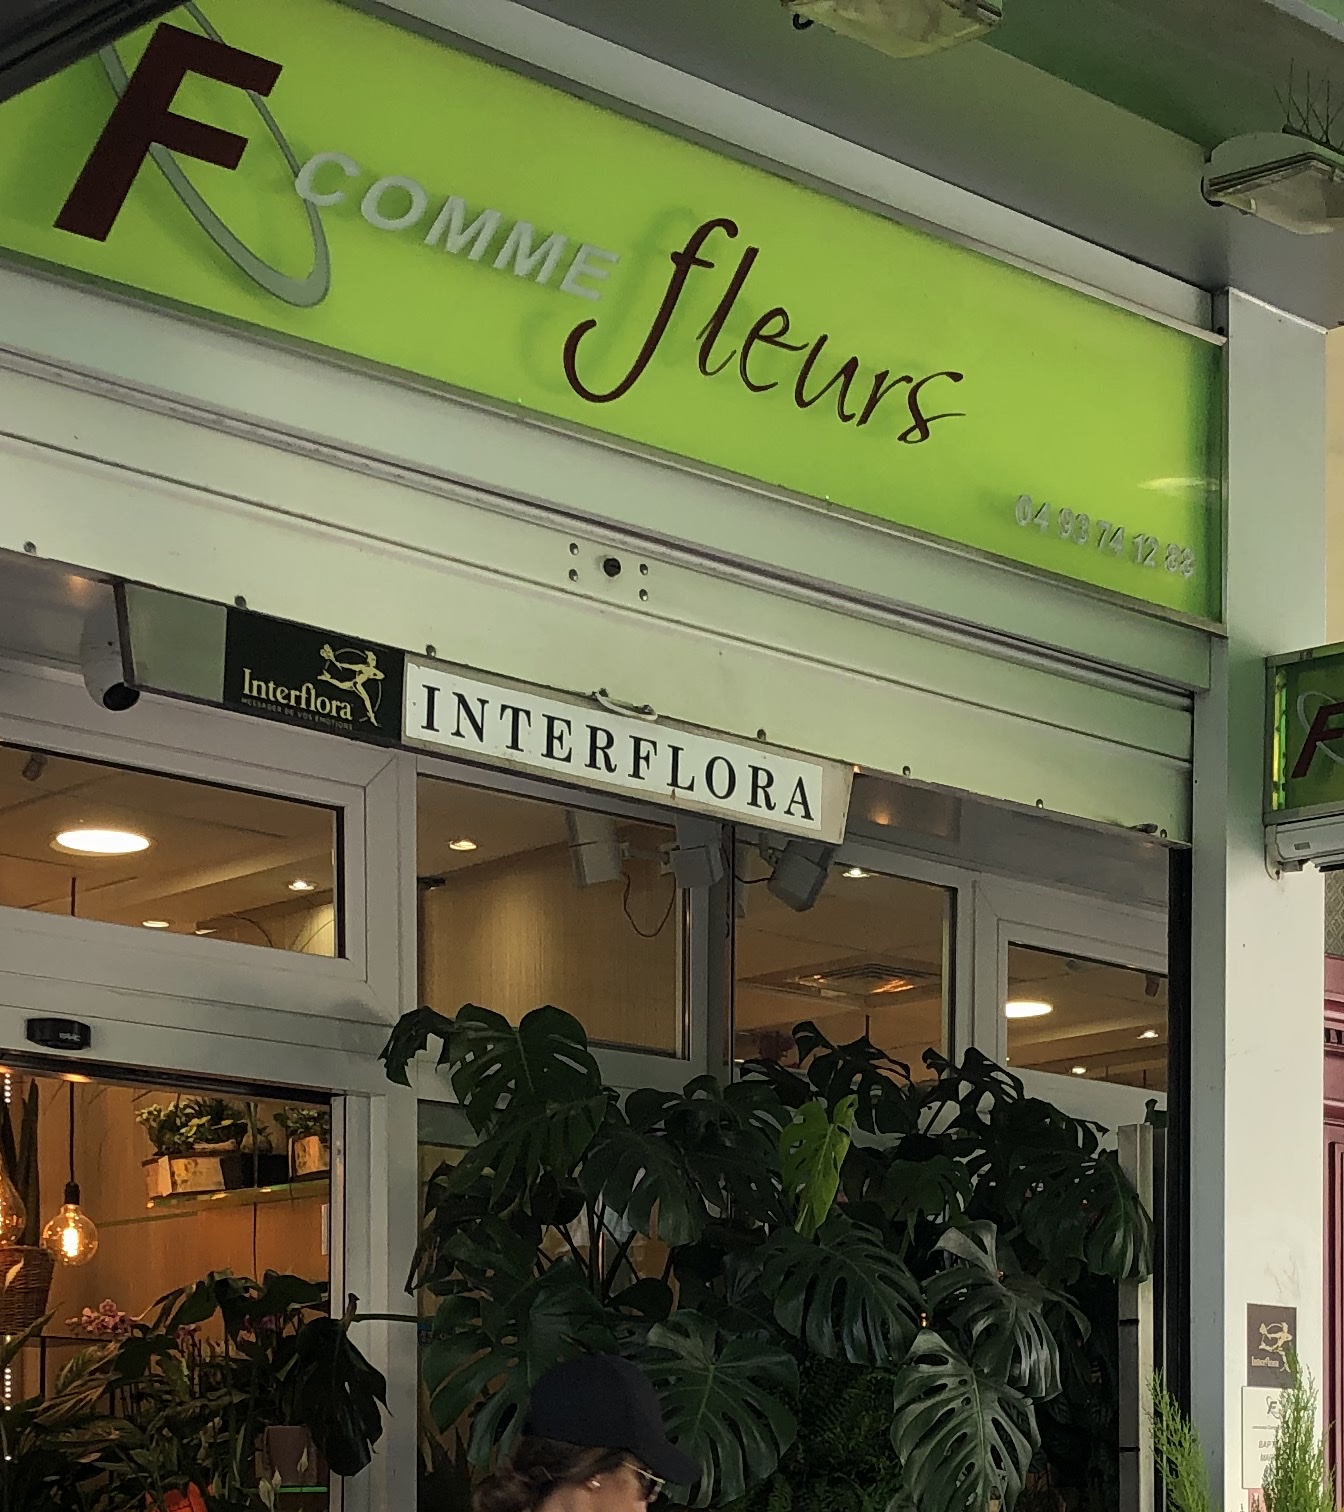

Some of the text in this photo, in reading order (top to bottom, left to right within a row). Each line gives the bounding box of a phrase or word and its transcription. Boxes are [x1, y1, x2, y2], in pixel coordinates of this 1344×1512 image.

[53, 21, 967, 444] F COMME fleurs
[1015, 494, 1051, 533] 04
[1057, 507, 1091, 545] 93
[1096, 519, 1125, 556] 74
[1132, 533, 1159, 567] 12
[242, 667, 353, 721] Interflora
[420, 684, 815, 821] INTERFLORA
